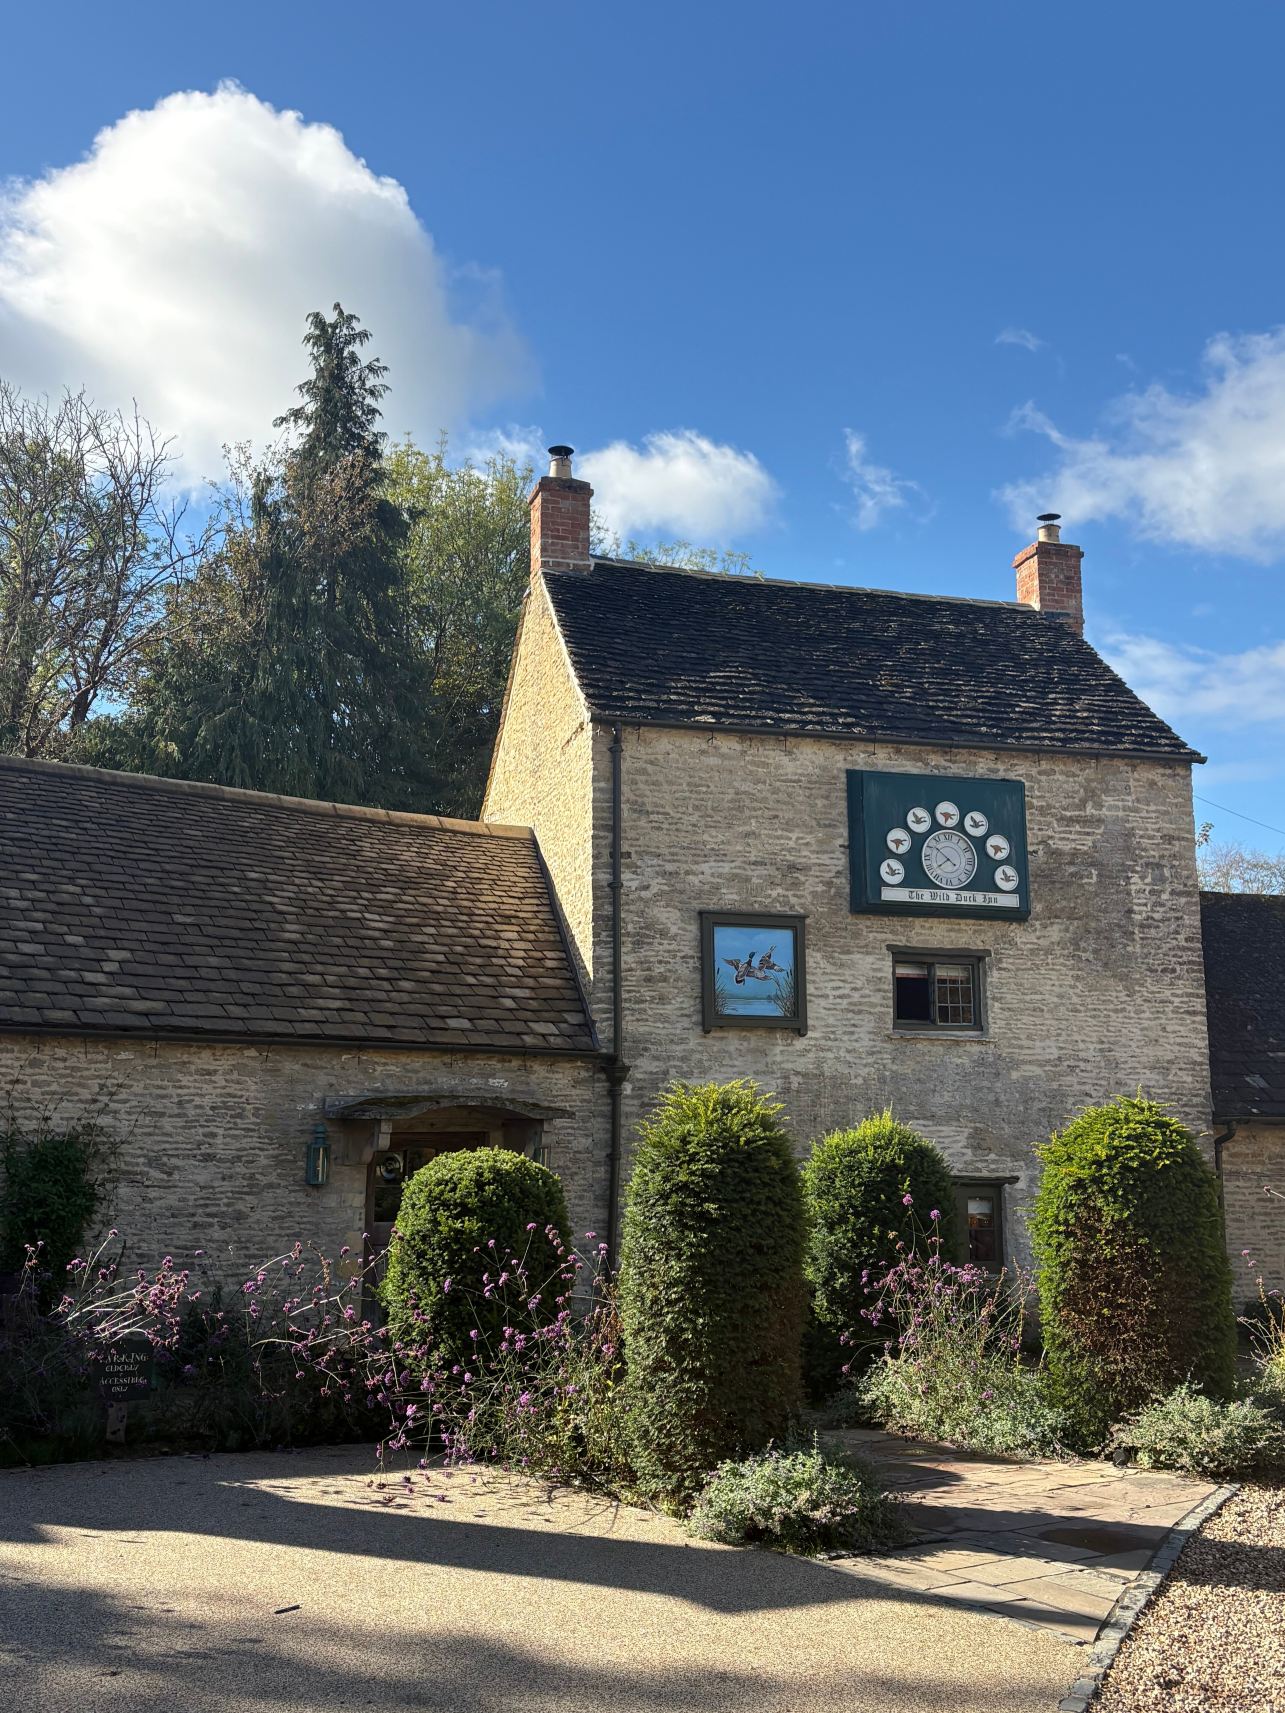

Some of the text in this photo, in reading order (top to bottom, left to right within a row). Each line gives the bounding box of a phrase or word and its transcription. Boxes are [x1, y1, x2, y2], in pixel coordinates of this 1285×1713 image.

[908, 890, 998, 904] The Wild Duck Inn
[101, 1352, 146, 1363] ARKING
